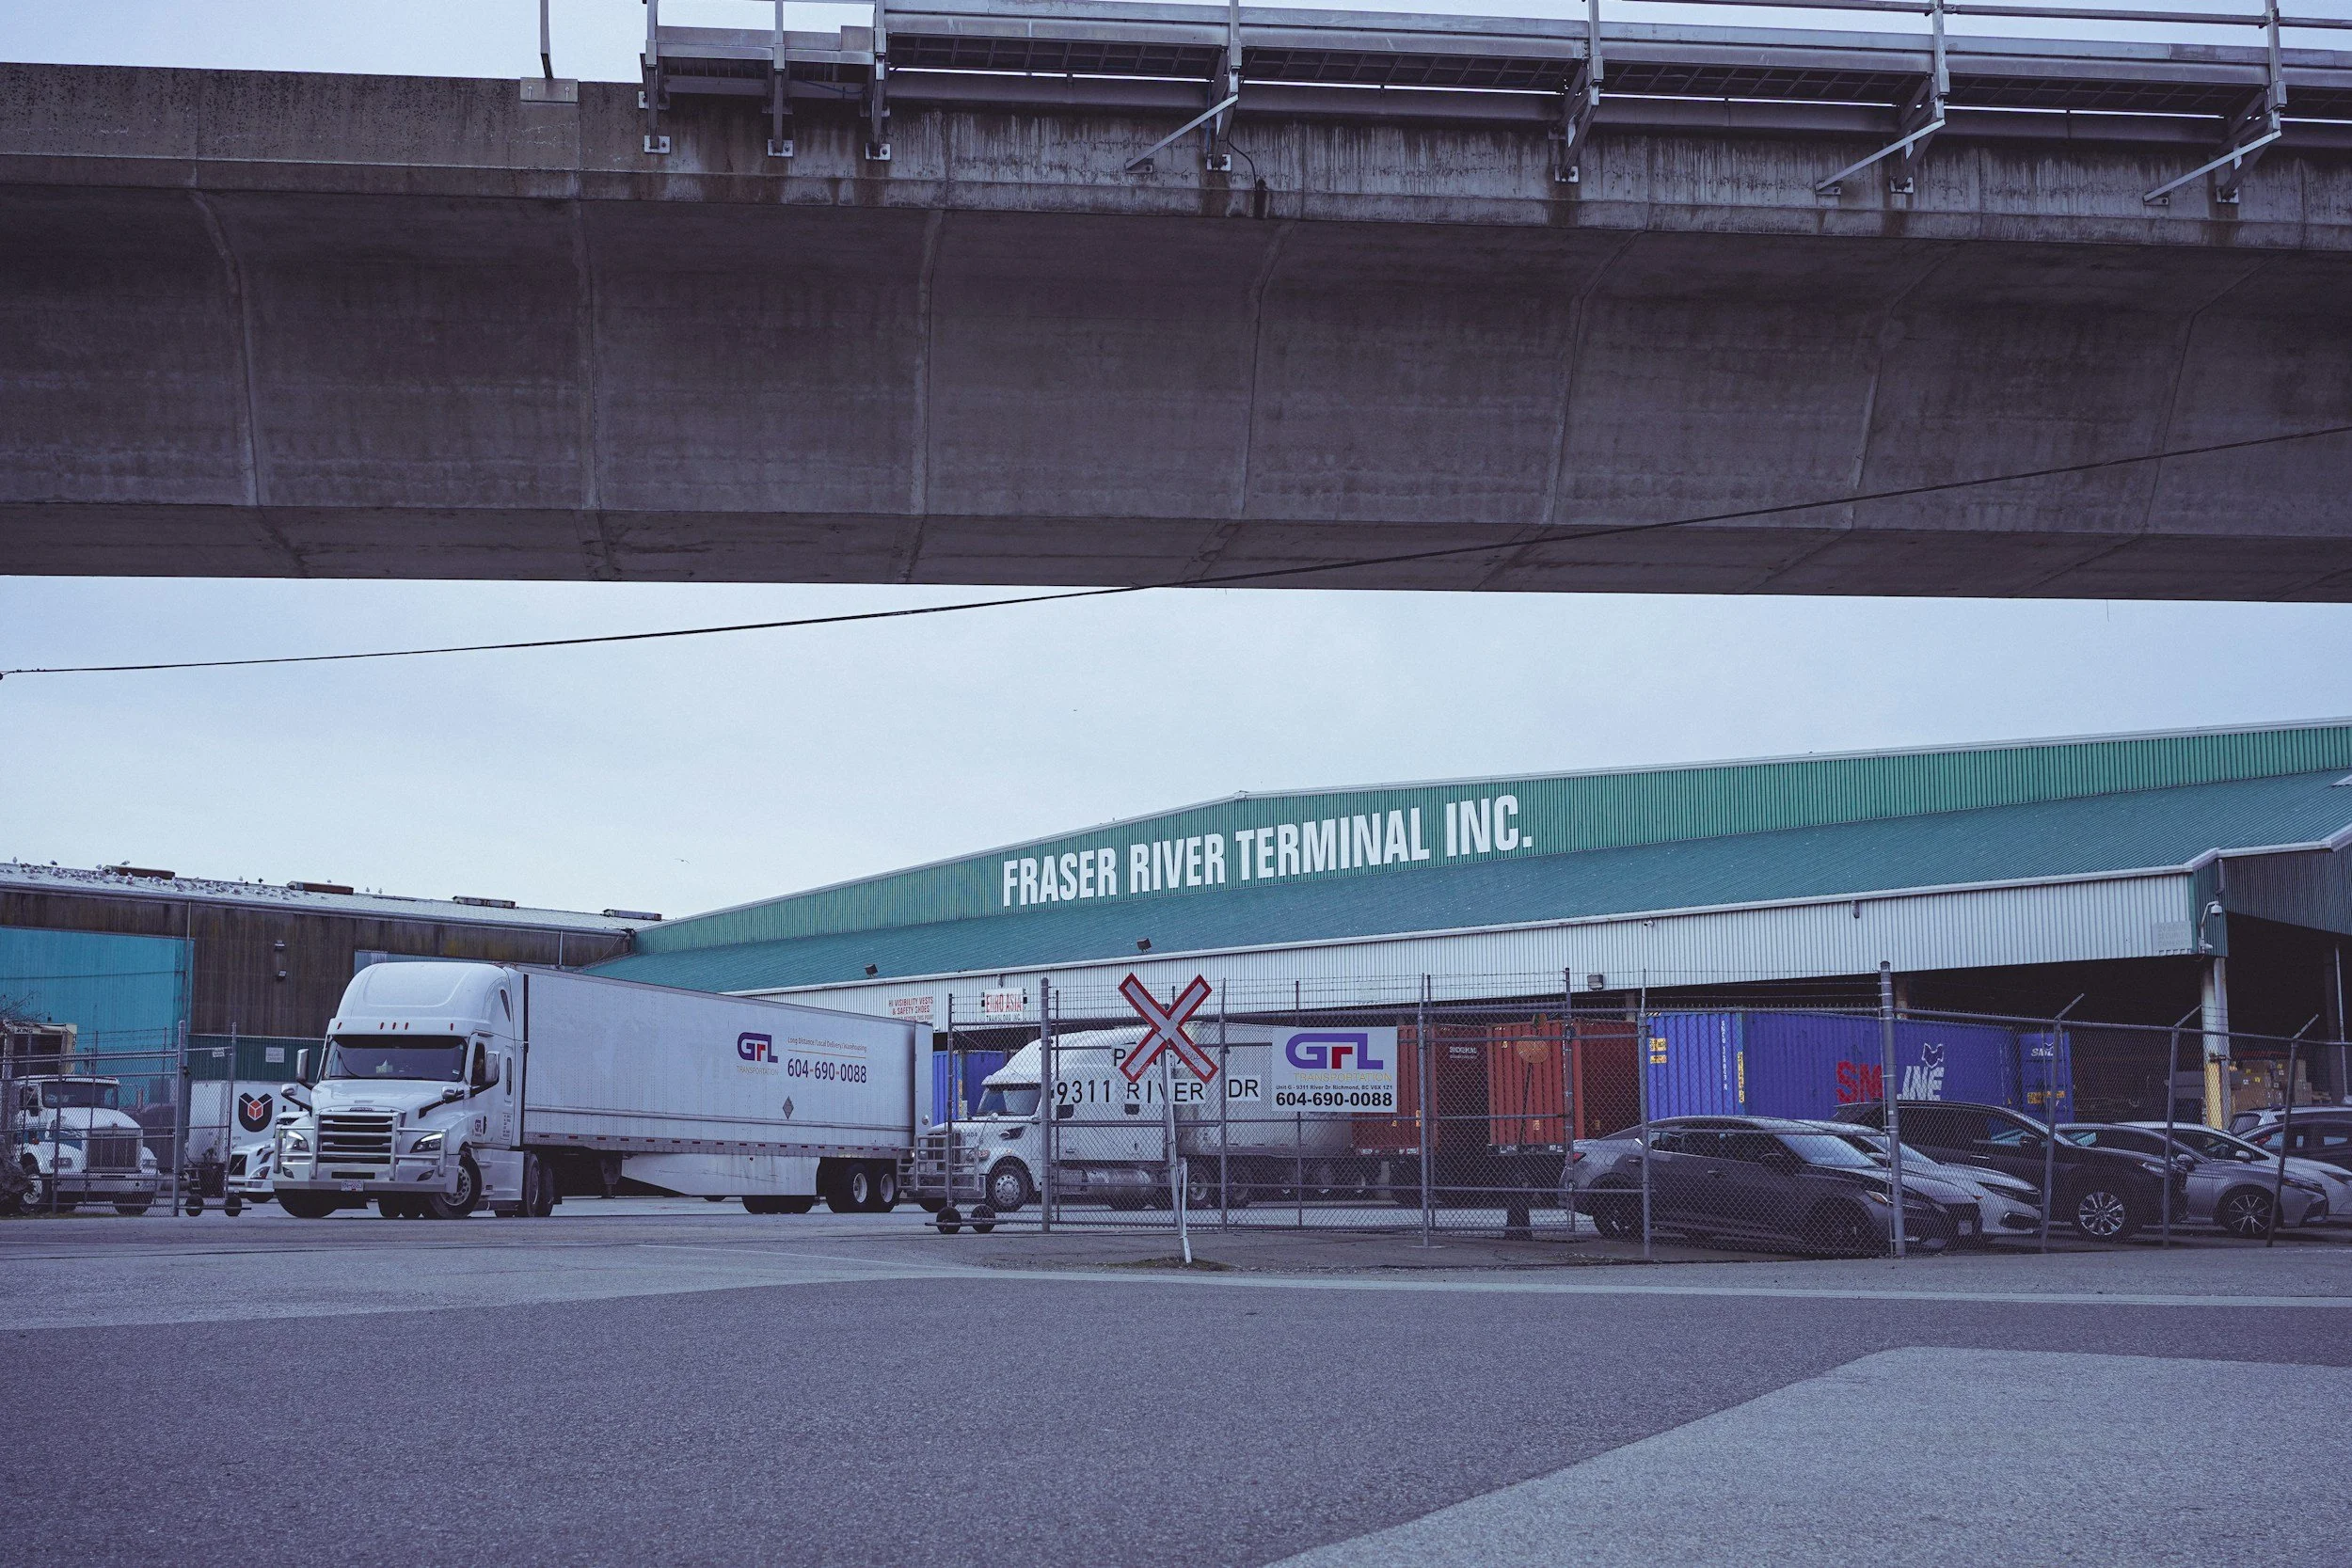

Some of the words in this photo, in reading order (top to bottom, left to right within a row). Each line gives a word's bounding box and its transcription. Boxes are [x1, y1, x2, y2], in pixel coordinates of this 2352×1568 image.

[1003, 847, 1117, 907] FRASER
[1130, 833, 1226, 895] RIVER
[1235, 807, 1430, 880] TERMINAL
[1445, 794, 1533, 859] INC.
[895, 997, 918, 1006] VISIBILITY
[919, 996, 934, 1005] VESTS
[986, 995, 1003, 1012] EURO
[1006, 994, 1022, 1012] ASIA
[898, 1006, 914, 1015] SAFETY
[915, 1006, 930, 1014] SHOES
[737, 1066, 779, 1076] TRANSPORTATION
[787, 1058, 866, 1083] 604-690-0088
[1294, 1072, 1391, 1082] TRANSPORTATION
[1836, 1060, 1883, 1103] SM
[1896, 1066, 1945, 1101] INE
[1057, 1080, 1110, 1105] 9311
[1229, 1079, 1259, 1099] DR
[1276, 1092, 1392, 1107] 604-690-0088
